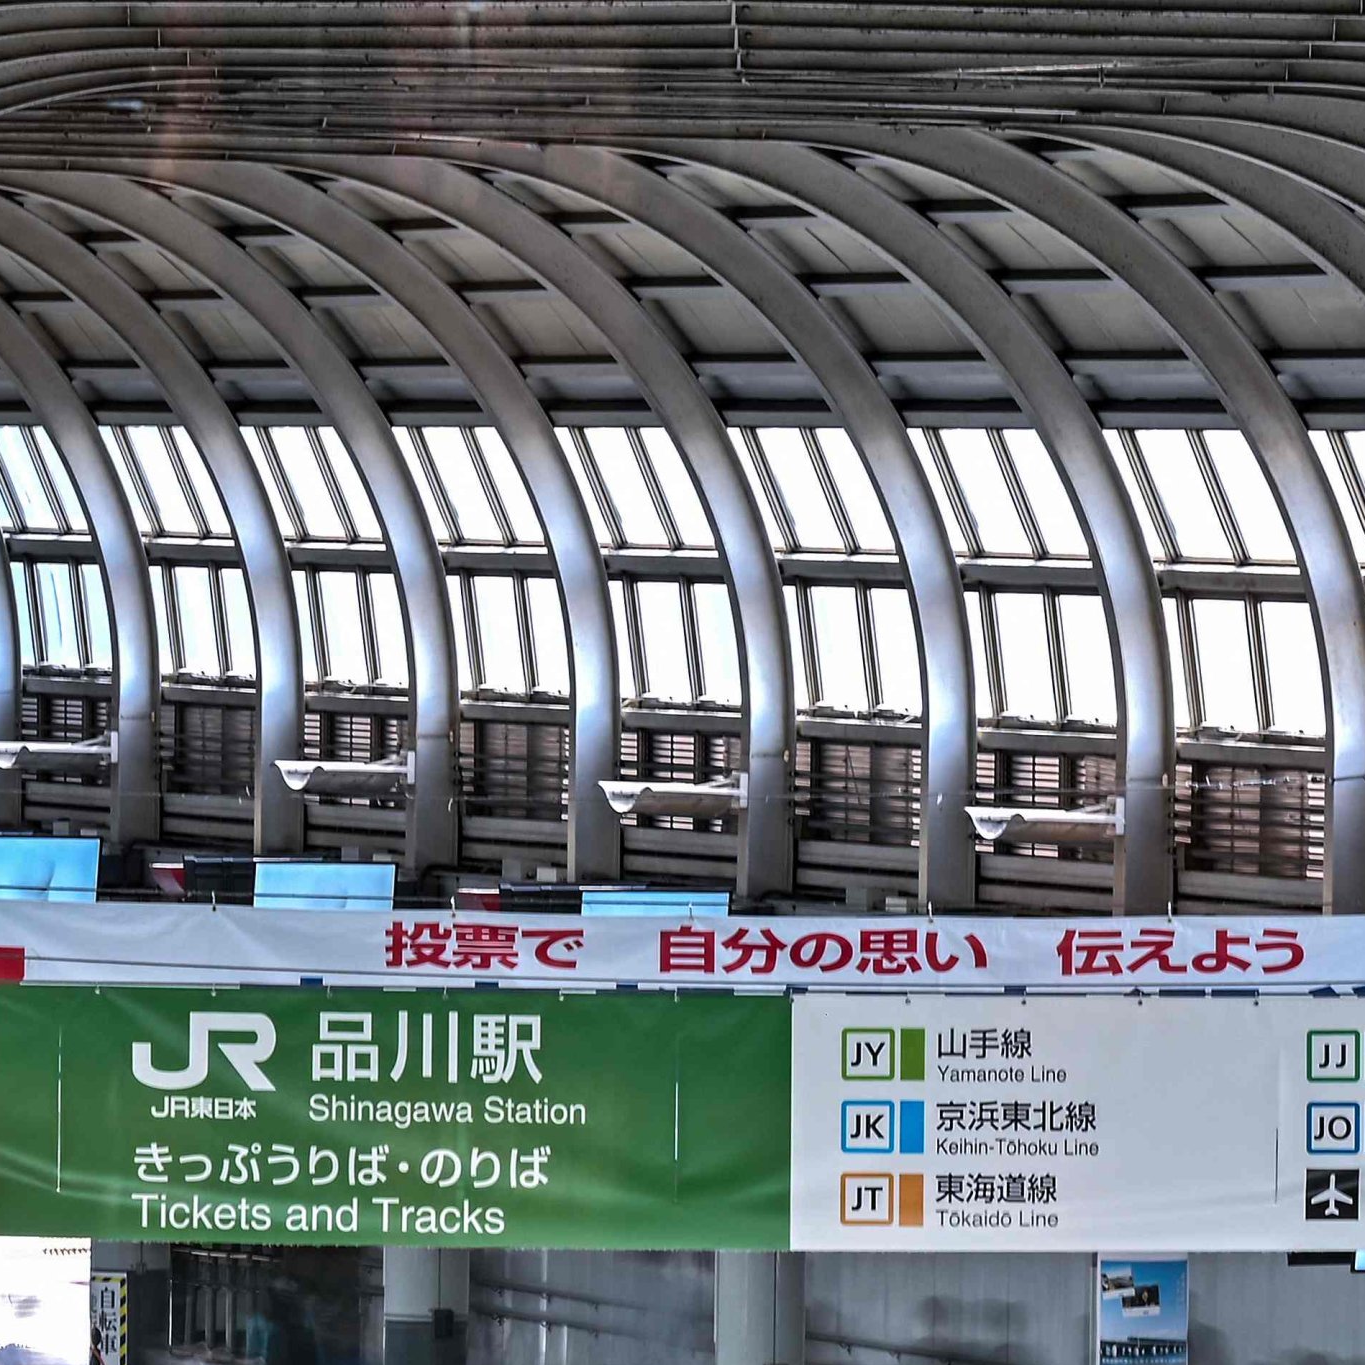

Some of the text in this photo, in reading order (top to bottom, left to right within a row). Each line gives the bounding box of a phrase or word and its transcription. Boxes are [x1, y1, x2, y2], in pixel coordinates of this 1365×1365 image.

[385, 922, 1305, 976] 投票で 自分の思い 伝えよう
[132, 1012, 276, 1090] JR
[312, 1012, 542, 1084] 品川駅
[851, 1042, 885, 1068] JY
[937, 1028, 1032, 1059] 山手線
[1319, 1044, 1347, 1068] JJ
[937, 1065, 1066, 1084] Yamanote Line
[151, 1097, 256, 1120] JR東日本
[309, 1095, 586, 1128] Shinagawa Station
[936, 1102, 1096, 1132] 京浜東北線
[850, 1115, 884, 1140] JK
[1315, 1116, 1351, 1140] JO
[936, 1138, 1099, 1156] Keihin-Tōhoku Line
[134, 1144, 551, 1188] きっぷうりば・のりば
[851, 1187, 883, 1211] JT
[936, 1174, 1057, 1204] 東海道線
[132, 1193, 505, 1234] Tickets and Tracks
[936, 1209, 1059, 1228] Tōkaidō Line
